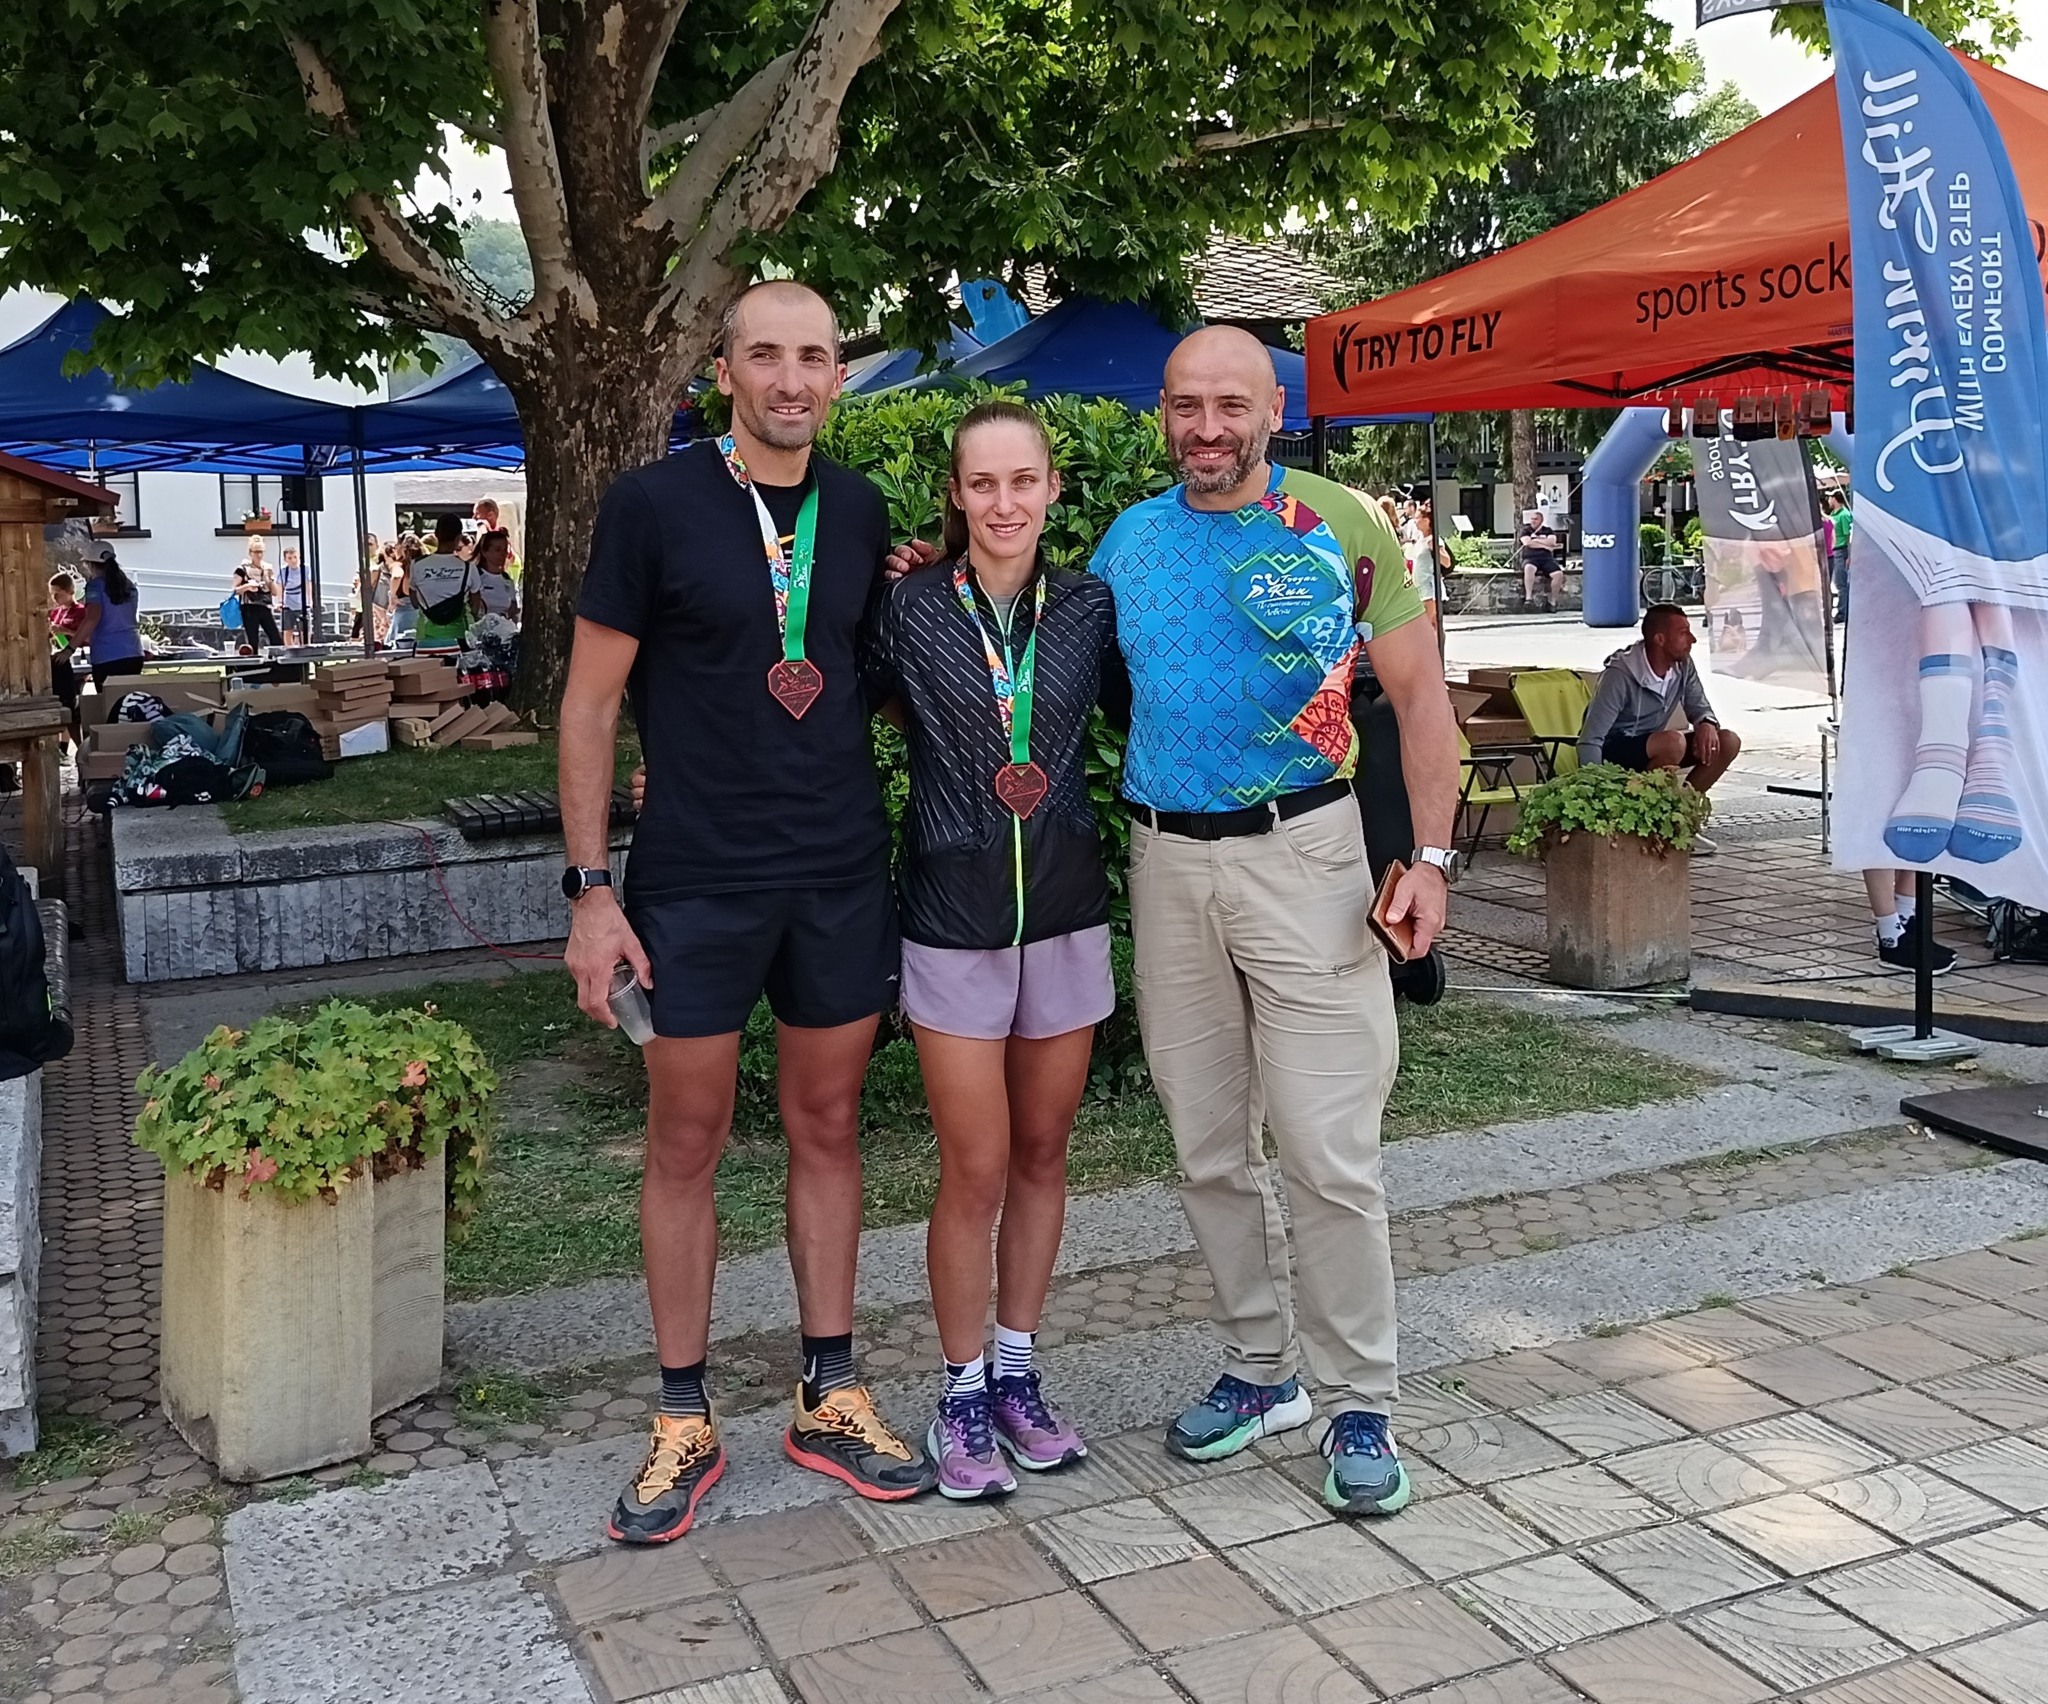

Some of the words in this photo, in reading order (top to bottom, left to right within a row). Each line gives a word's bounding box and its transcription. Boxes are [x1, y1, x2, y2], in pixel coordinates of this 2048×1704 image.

[1636, 269, 1746, 333] sports
[1759, 240, 1851, 304] sock
[1353, 331, 1402, 373] TRY
[1407, 323, 1444, 364] TO
[1450, 310, 1502, 356] FLY
[1267, 584, 1311, 598] Run
